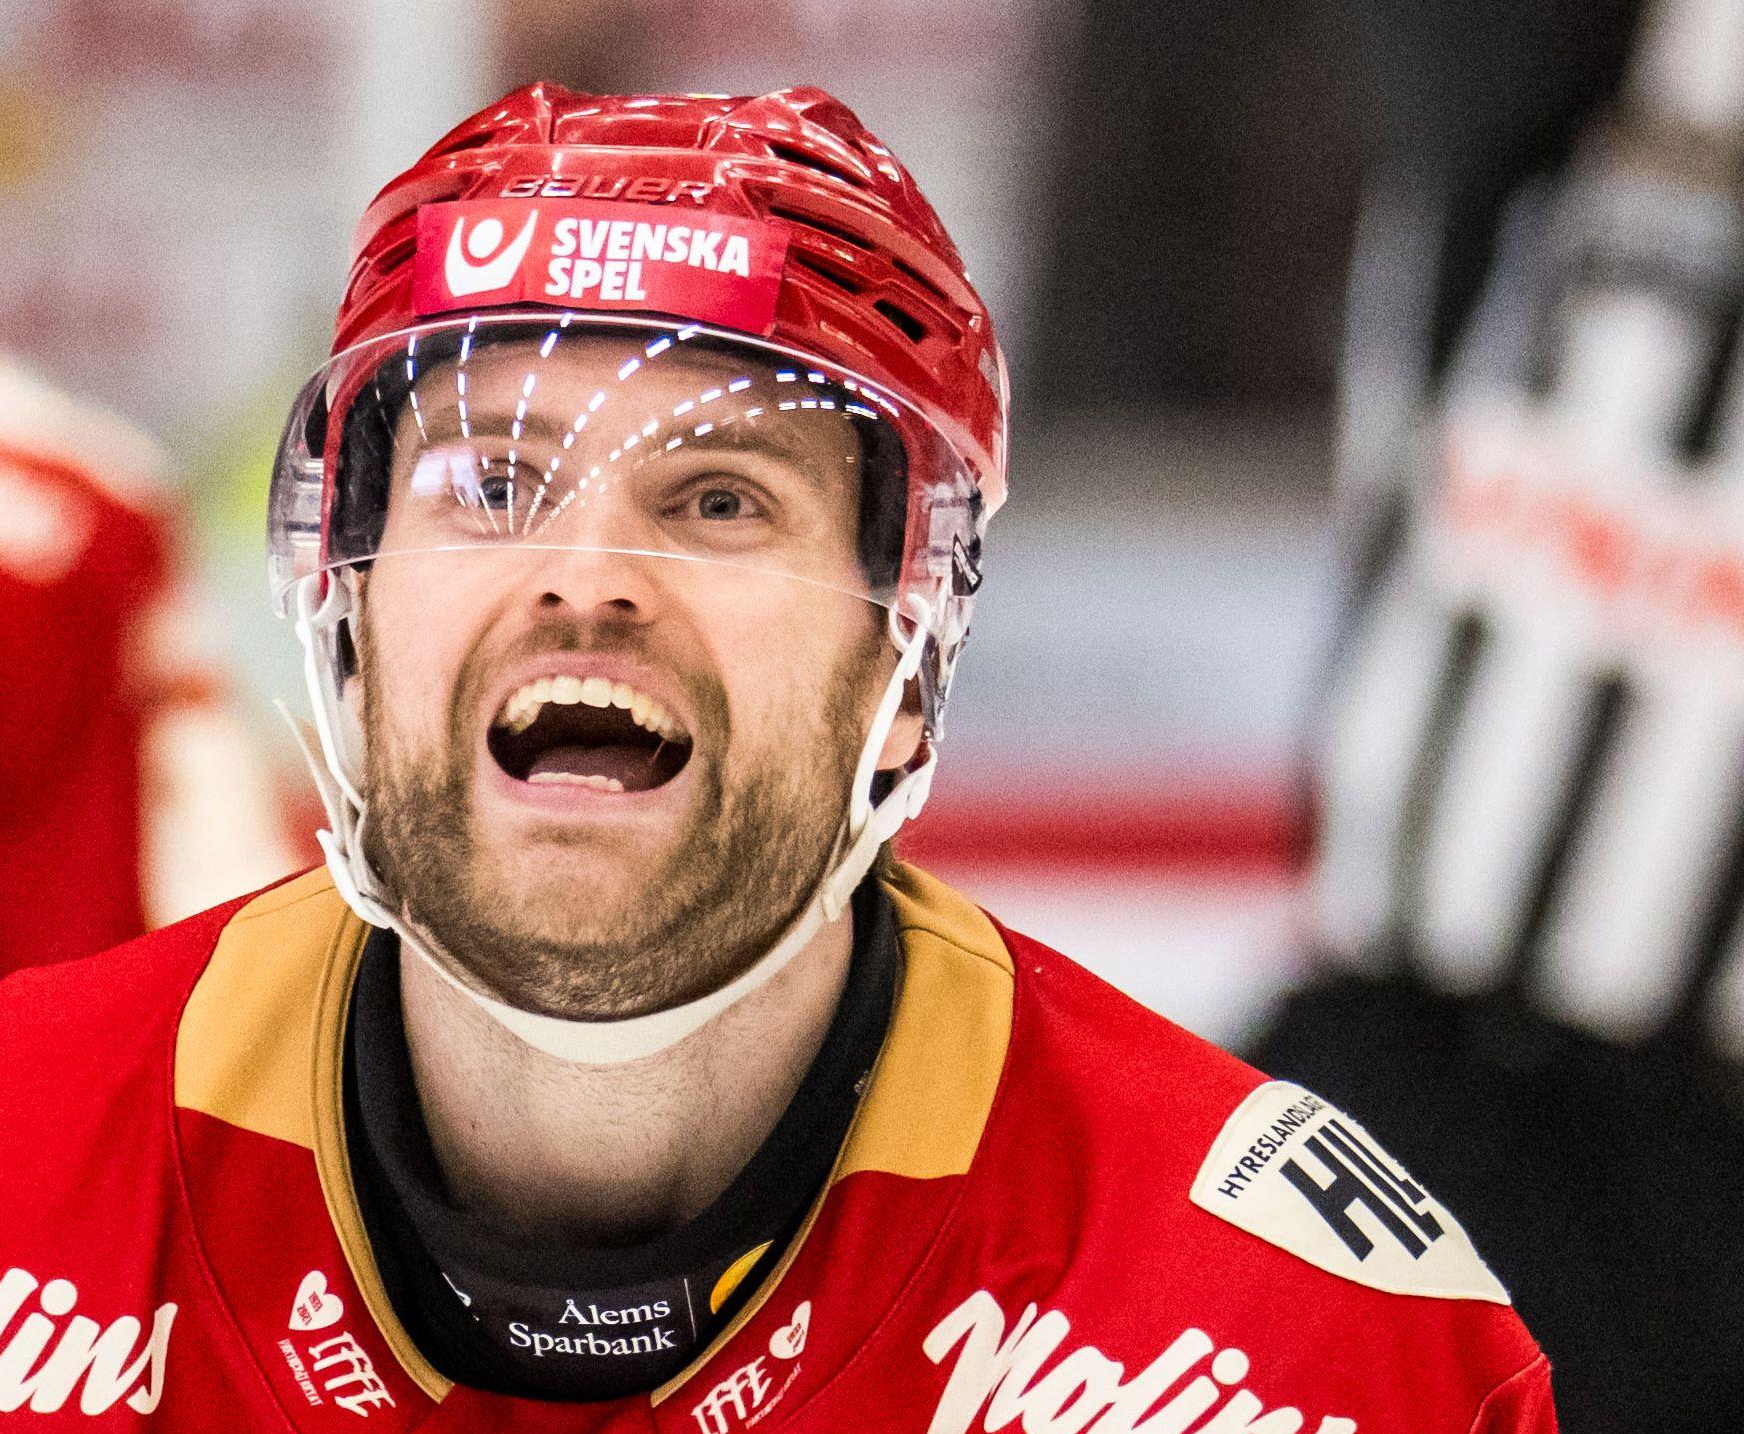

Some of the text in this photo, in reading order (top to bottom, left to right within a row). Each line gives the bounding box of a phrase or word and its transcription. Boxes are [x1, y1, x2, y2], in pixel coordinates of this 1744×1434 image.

[551, 217, 750, 277] SVENSKA
[544, 258, 647, 301] SPEL
[558, 1299, 671, 1326] Ålems
[509, 1322, 676, 1357] Sparbank
